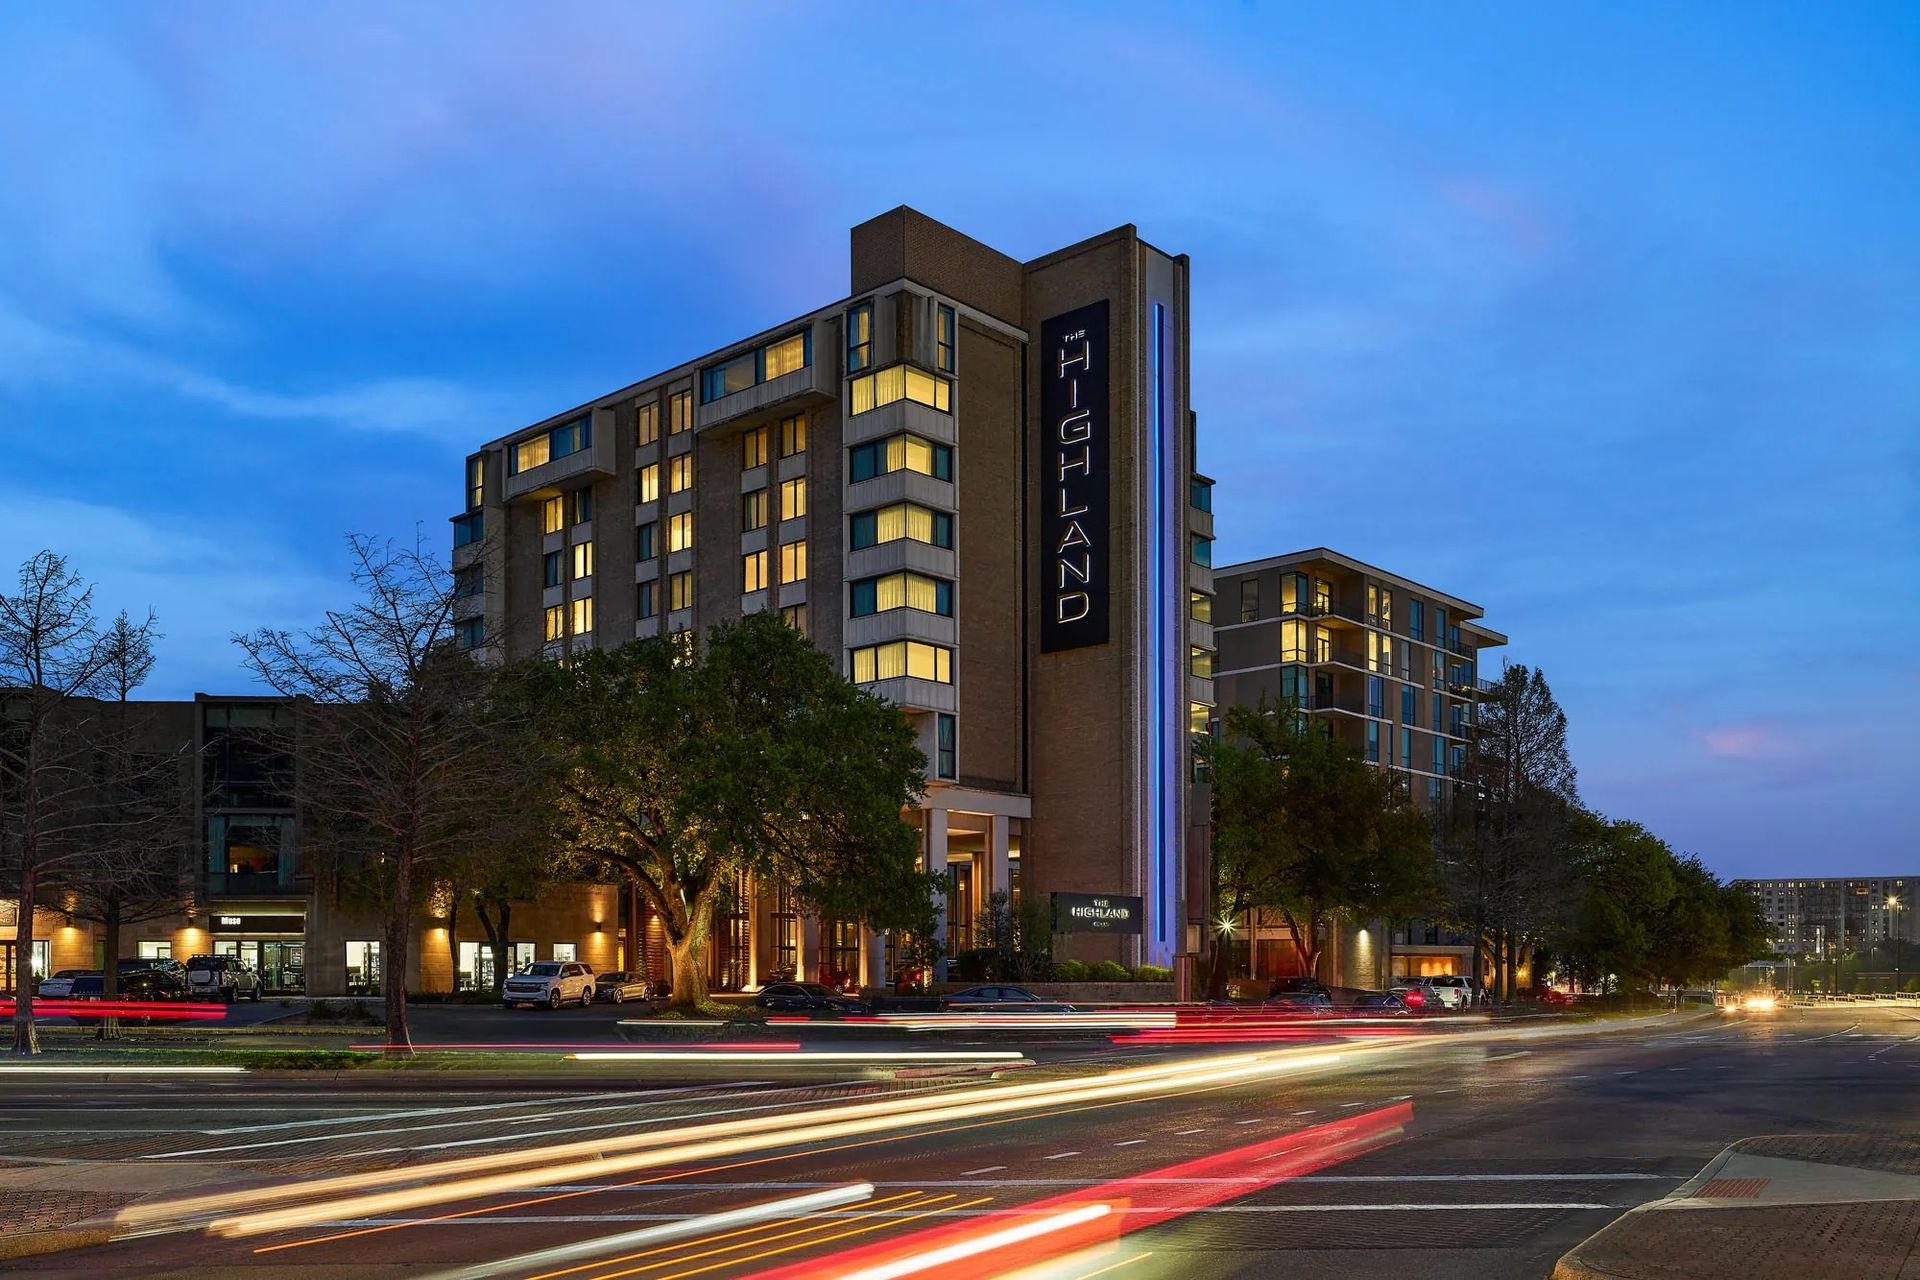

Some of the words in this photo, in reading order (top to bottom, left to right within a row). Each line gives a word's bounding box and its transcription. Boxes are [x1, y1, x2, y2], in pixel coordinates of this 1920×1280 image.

[1062, 329, 1086, 343] THE
[1057, 340, 1091, 624] HIGHLAND
[1093, 899, 1110, 908] THE
[1071, 907, 1131, 919] HIGHLAND
